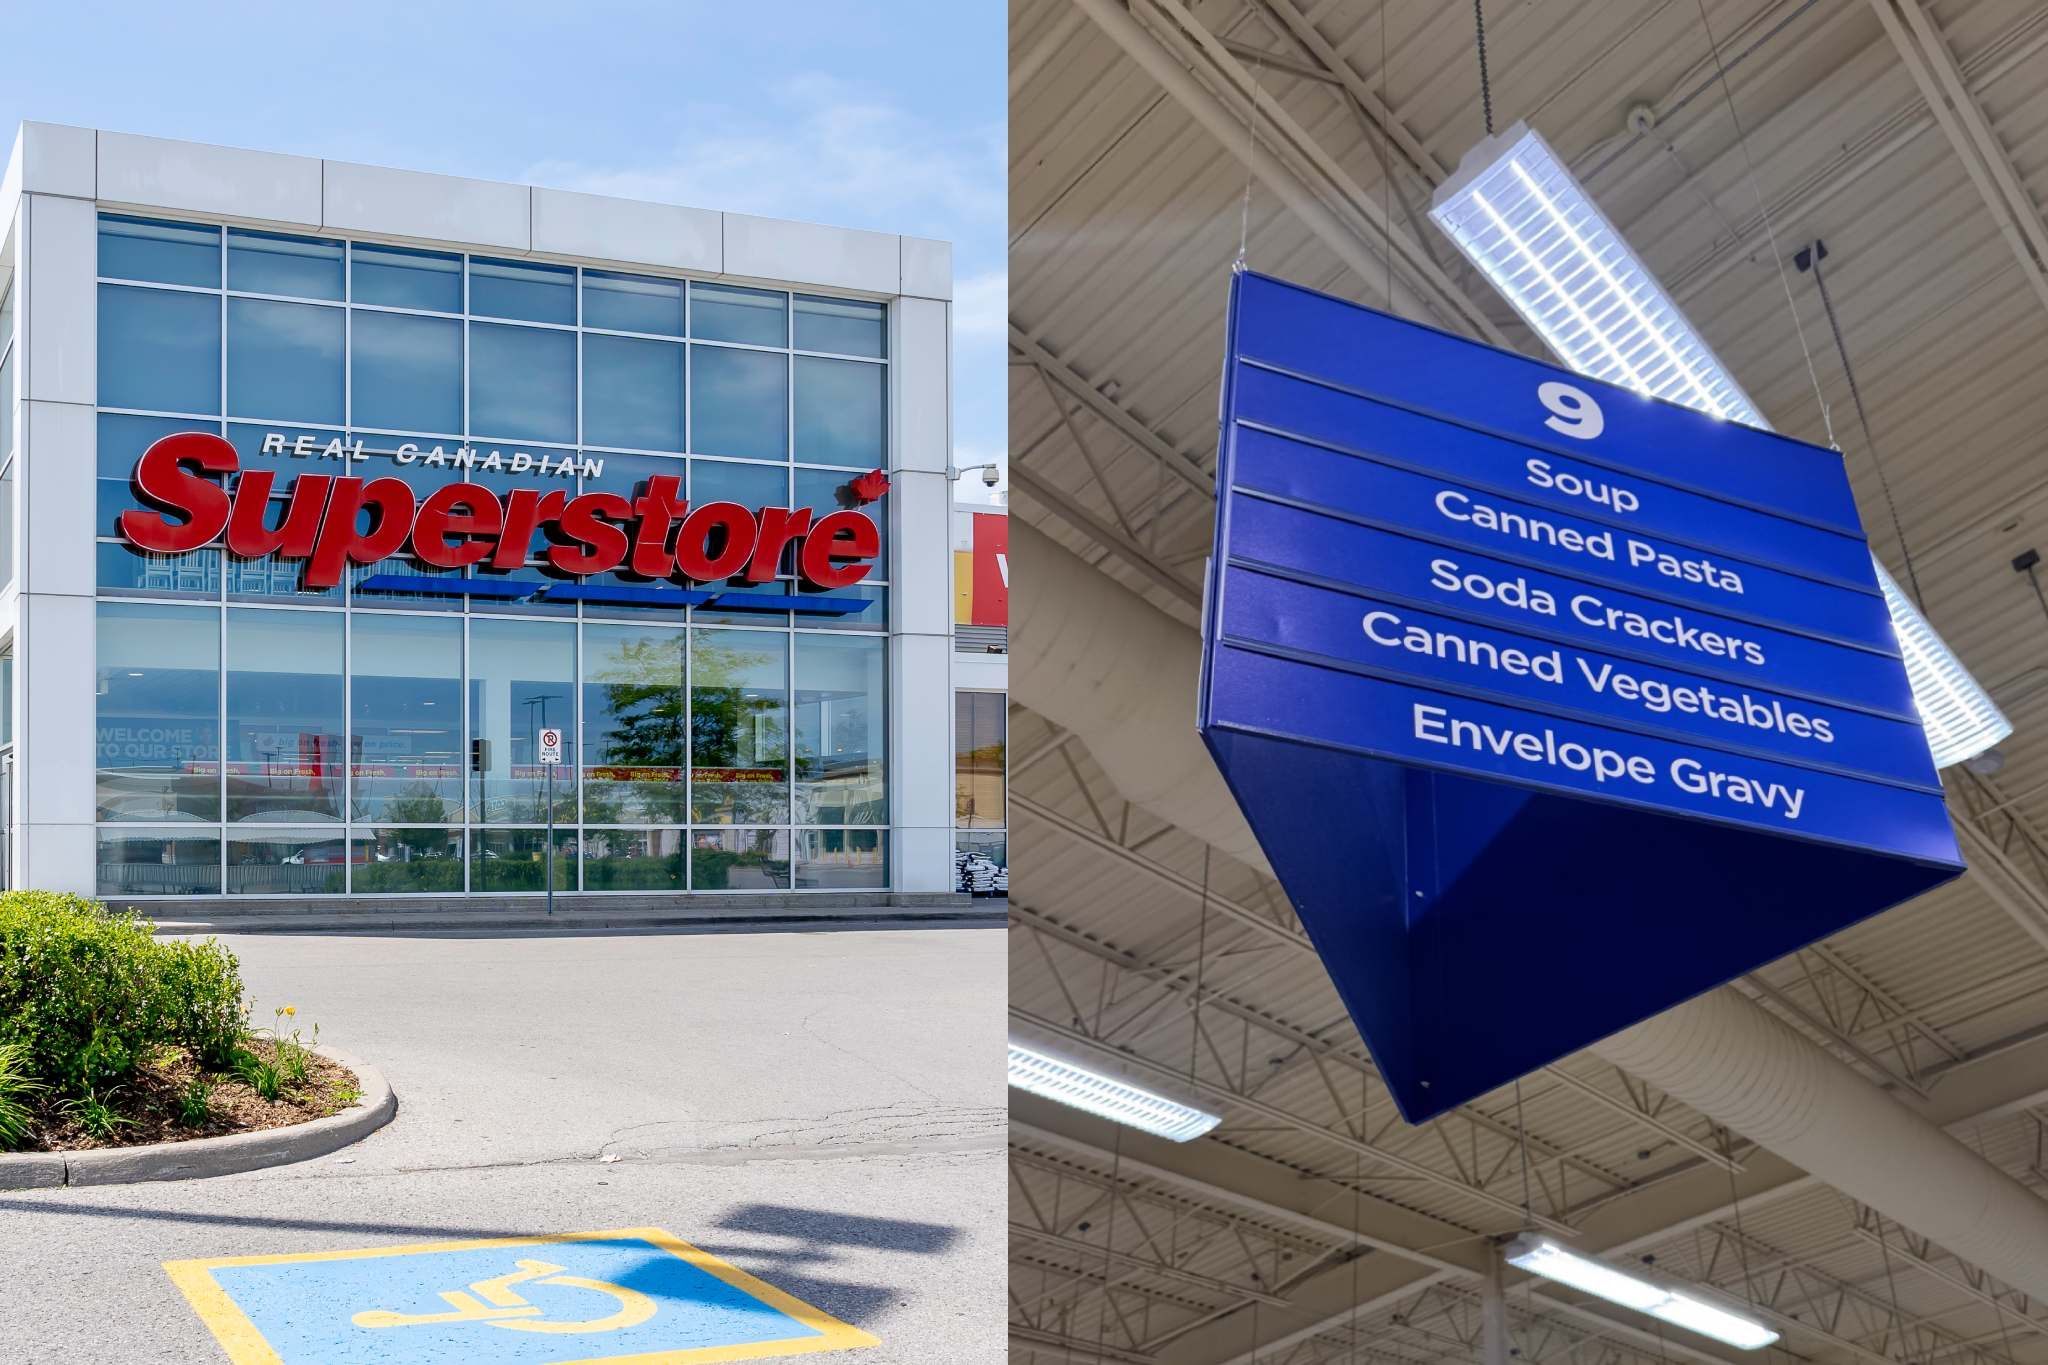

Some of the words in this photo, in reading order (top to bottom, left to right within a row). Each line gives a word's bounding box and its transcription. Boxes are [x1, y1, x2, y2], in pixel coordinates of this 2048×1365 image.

[1538, 381, 1605, 440] 9
[262, 433, 370, 461] REAL
[393, 443, 605, 479] CANADIAN
[1526, 458, 1640, 514] Soup
[120, 431, 880, 589] Superstore
[1435, 490, 1615, 562] Canned
[1628, 539, 1745, 595] Pasta
[1431, 559, 1557, 617] Soda
[1571, 595, 1766, 667] Crackers
[1362, 611, 1564, 686] Canned
[1577, 657, 1835, 744] Vegetables
[96, 727, 193, 744] WELCOME
[96, 742, 120, 758] TO
[125, 743, 168, 760] OUR
[1413, 703, 1657, 785] Envelope
[1670, 758, 1806, 820] Gravy
